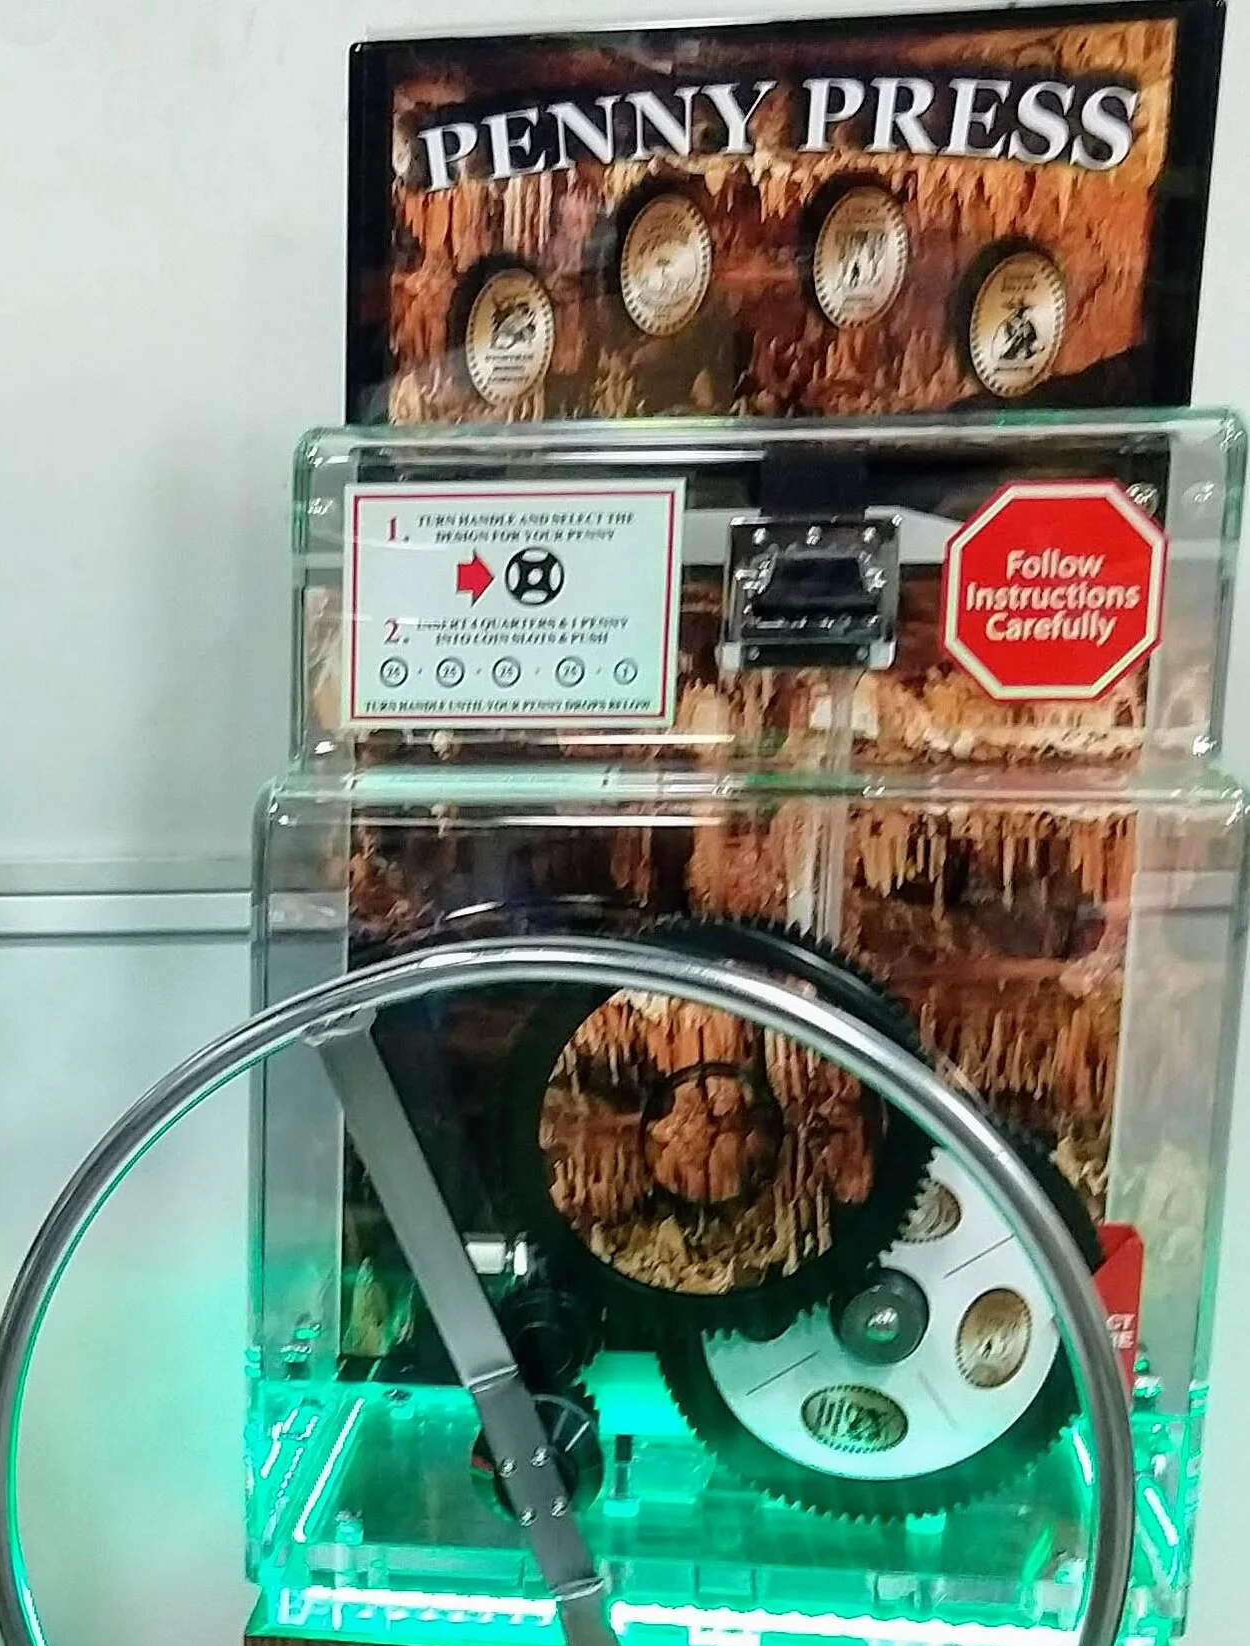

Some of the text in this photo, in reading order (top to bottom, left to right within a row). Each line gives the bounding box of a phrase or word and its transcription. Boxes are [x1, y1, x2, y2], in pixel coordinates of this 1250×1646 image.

[417, 77, 1140, 192] PENNY PRESS
[1006, 547, 1105, 580] Follow
[966, 581, 1141, 611] Instructions
[985, 610, 1118, 648] Carefully
